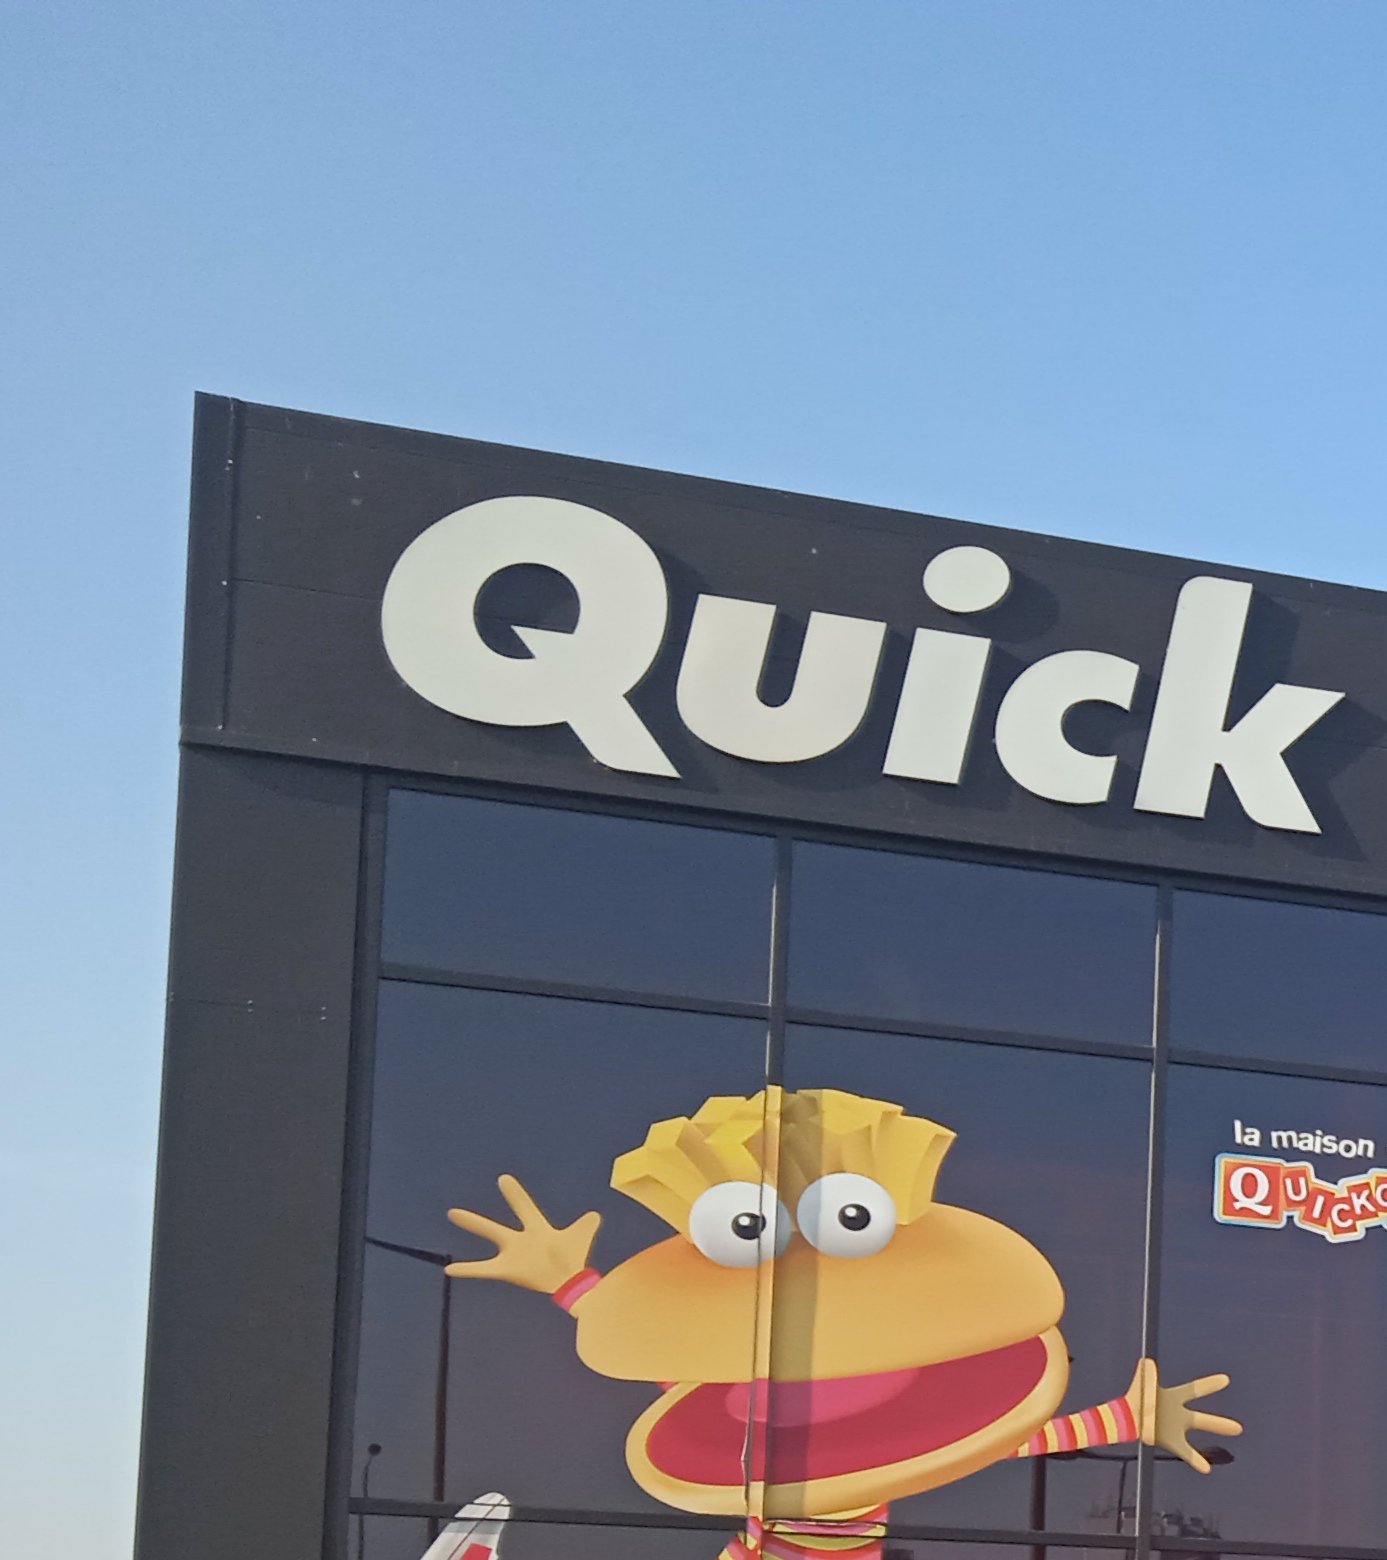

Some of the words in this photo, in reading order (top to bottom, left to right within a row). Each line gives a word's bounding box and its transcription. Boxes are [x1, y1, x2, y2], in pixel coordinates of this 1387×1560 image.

[380, 494, 1346, 834] Quick
[1233, 1119, 1261, 1147] la
[1270, 1129, 1375, 1159] maison
